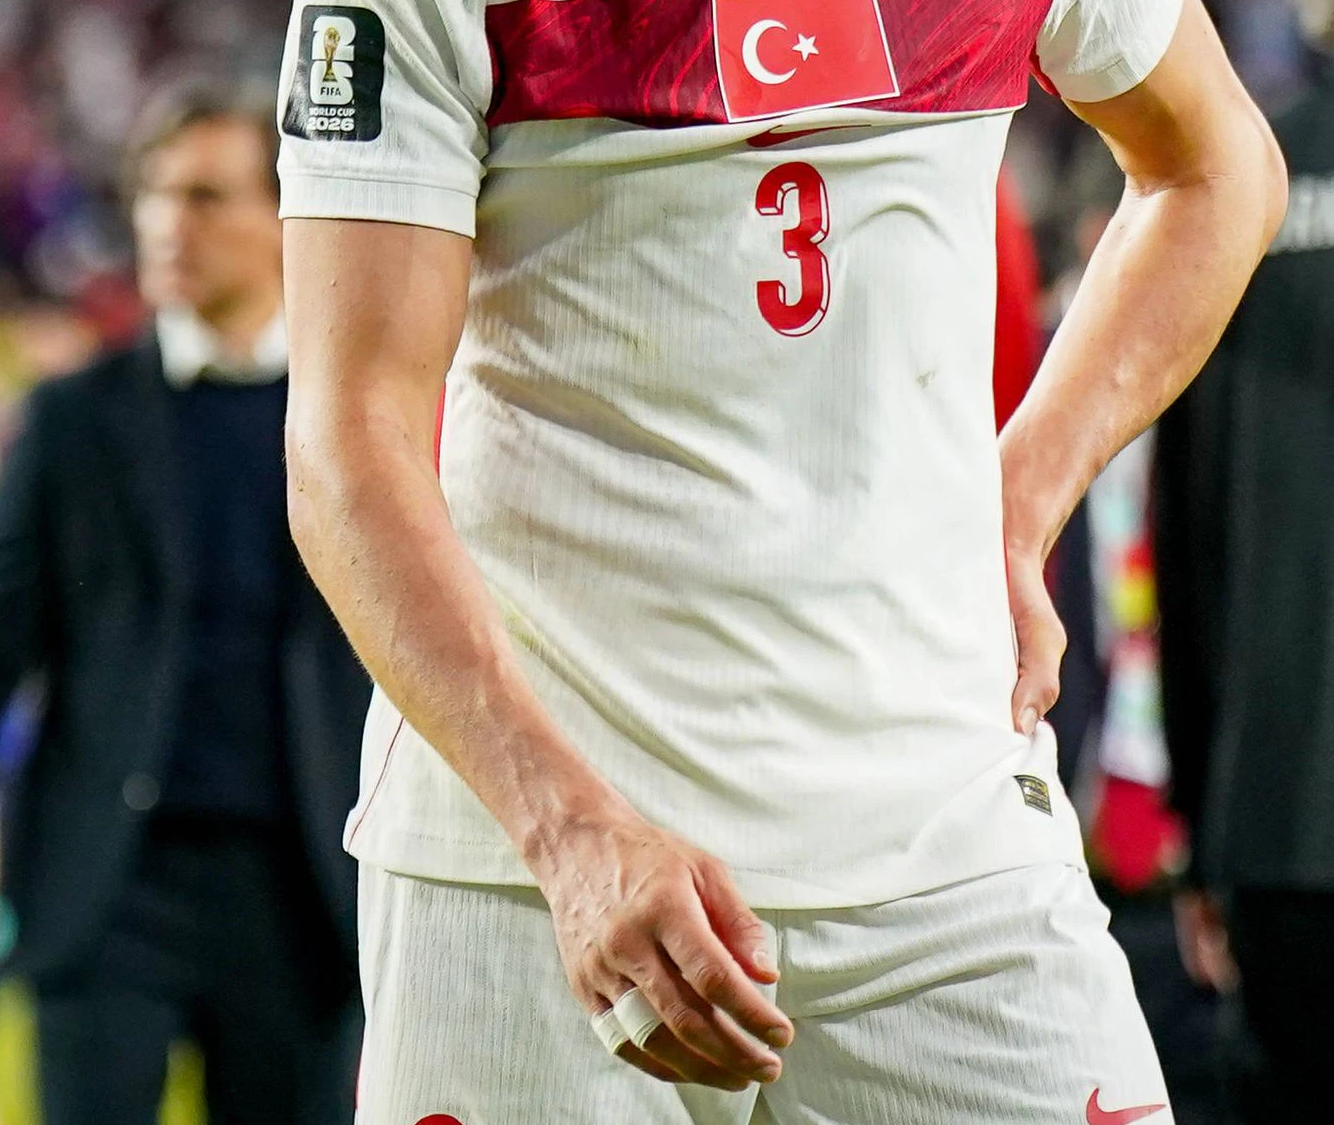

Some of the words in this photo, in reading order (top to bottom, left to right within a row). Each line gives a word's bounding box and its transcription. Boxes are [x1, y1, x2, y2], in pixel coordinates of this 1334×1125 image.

[320, 86, 342, 96] FIFA
[337, 107, 355, 116] CUP
[306, 117, 354, 131] 2026
[755, 161, 830, 337] 3
